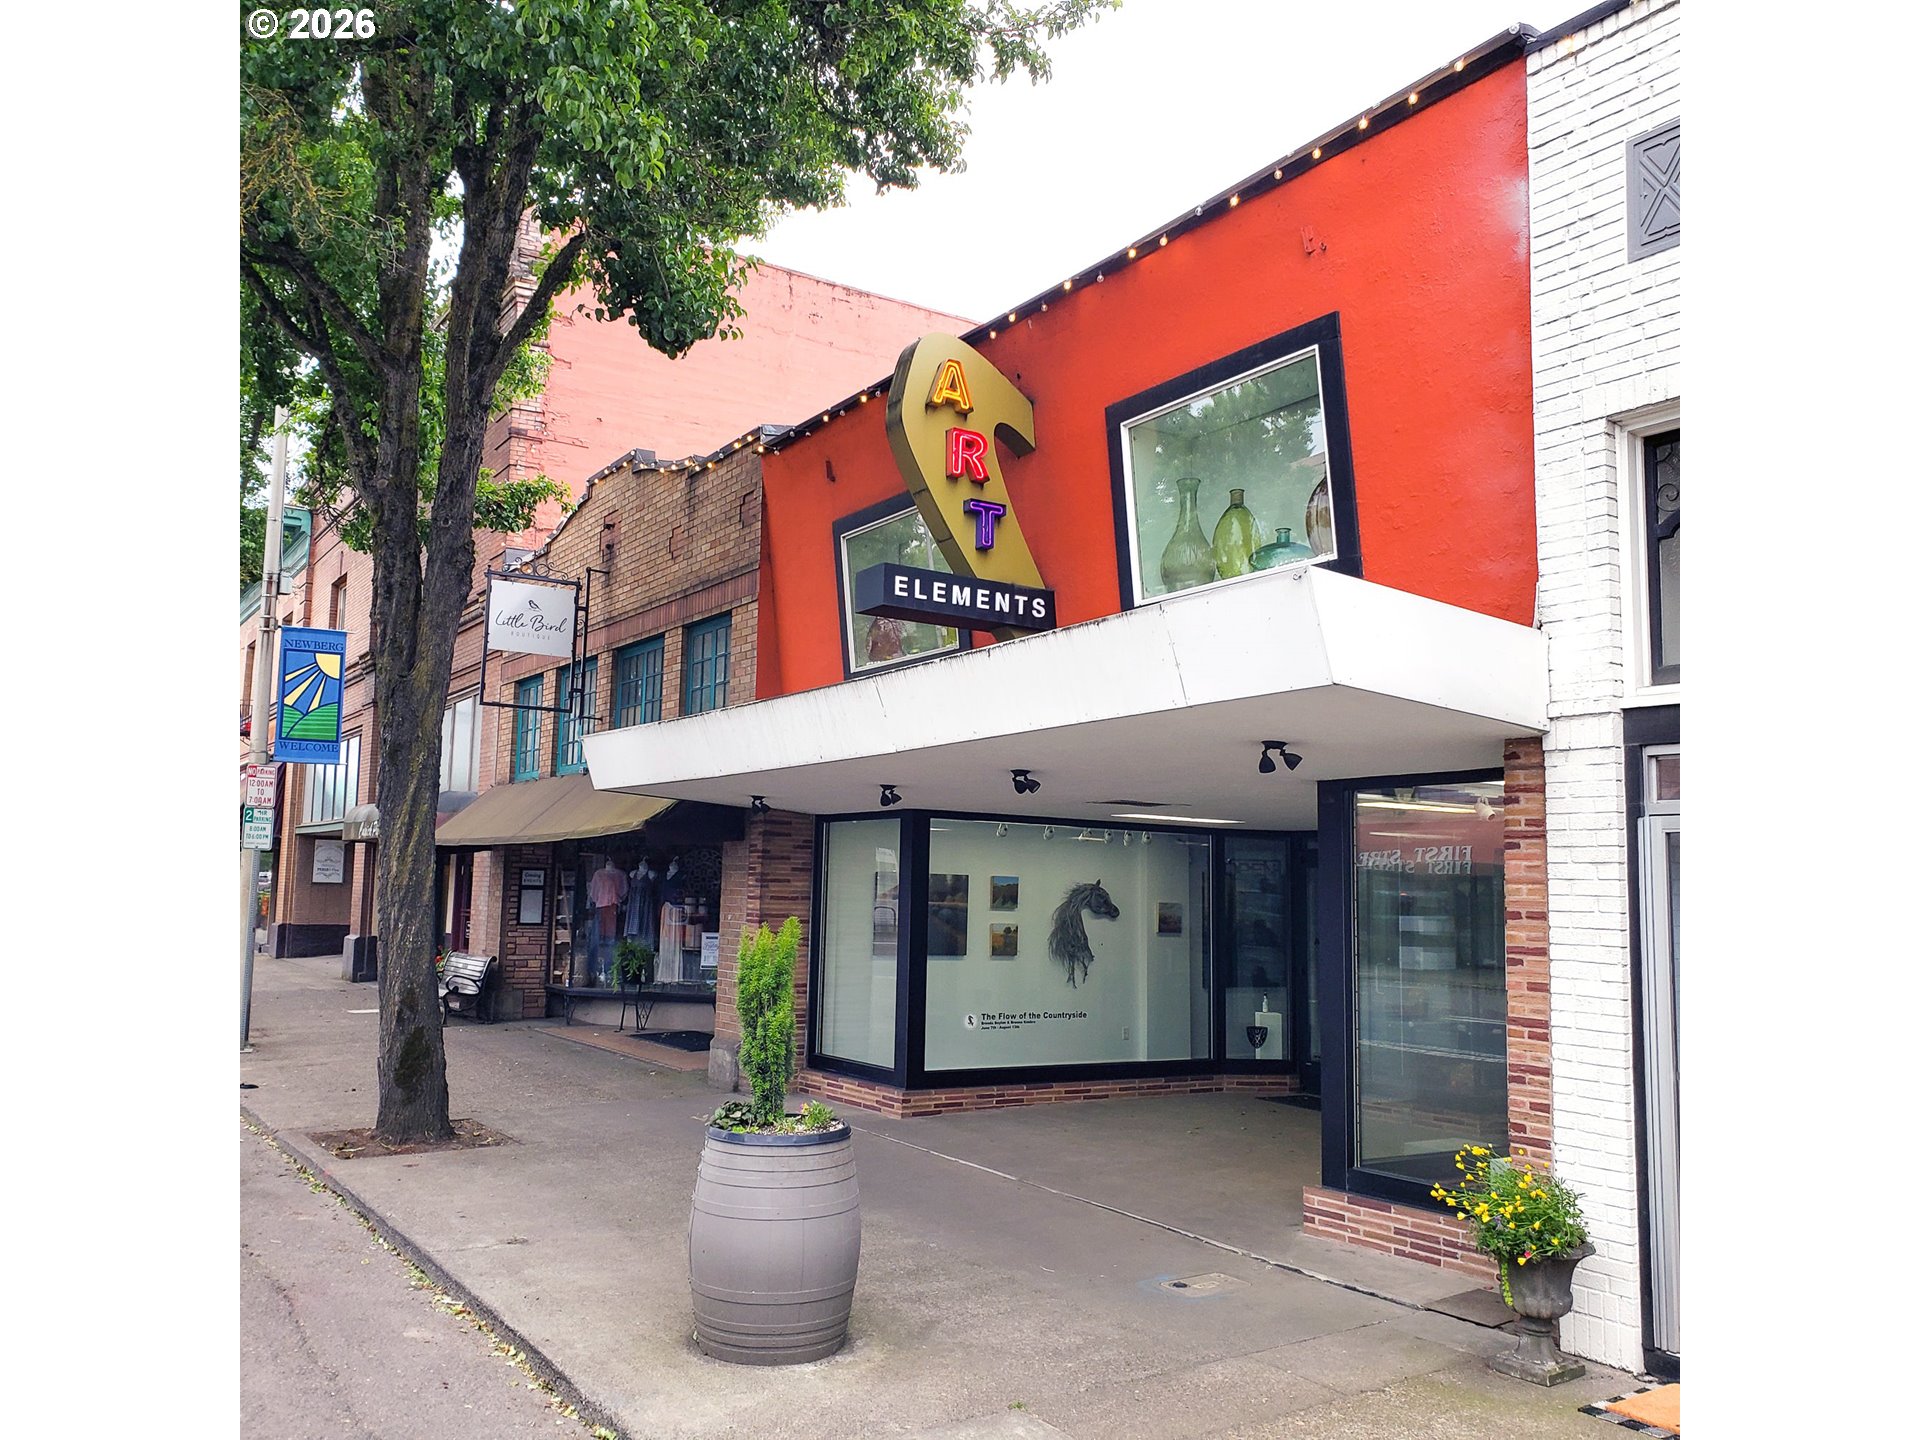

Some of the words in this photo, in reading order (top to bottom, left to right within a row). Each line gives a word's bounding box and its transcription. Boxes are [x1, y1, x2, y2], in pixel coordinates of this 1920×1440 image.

[926, 358, 1007, 550] ART
[894, 575, 1046, 618] ELEMENTS
[495, 609, 528, 629] Little
[529, 614, 568, 633] Bird
[510, 631, 551, 640] BOUTIQUE
[284, 638, 344, 652] NEWBERG
[279, 741, 339, 753] WELCOME
[248, 768, 257, 776] NO
[257, 788, 265, 796] TO
[245, 809, 253, 821] 2
[981, 1013, 996, 1021] The
[998, 1012, 1017, 1020] Flow
[1018, 1011, 1028, 1020] of
[1029, 1011, 1041, 1019] the
[1043, 1011, 1088, 1020] Countryside
